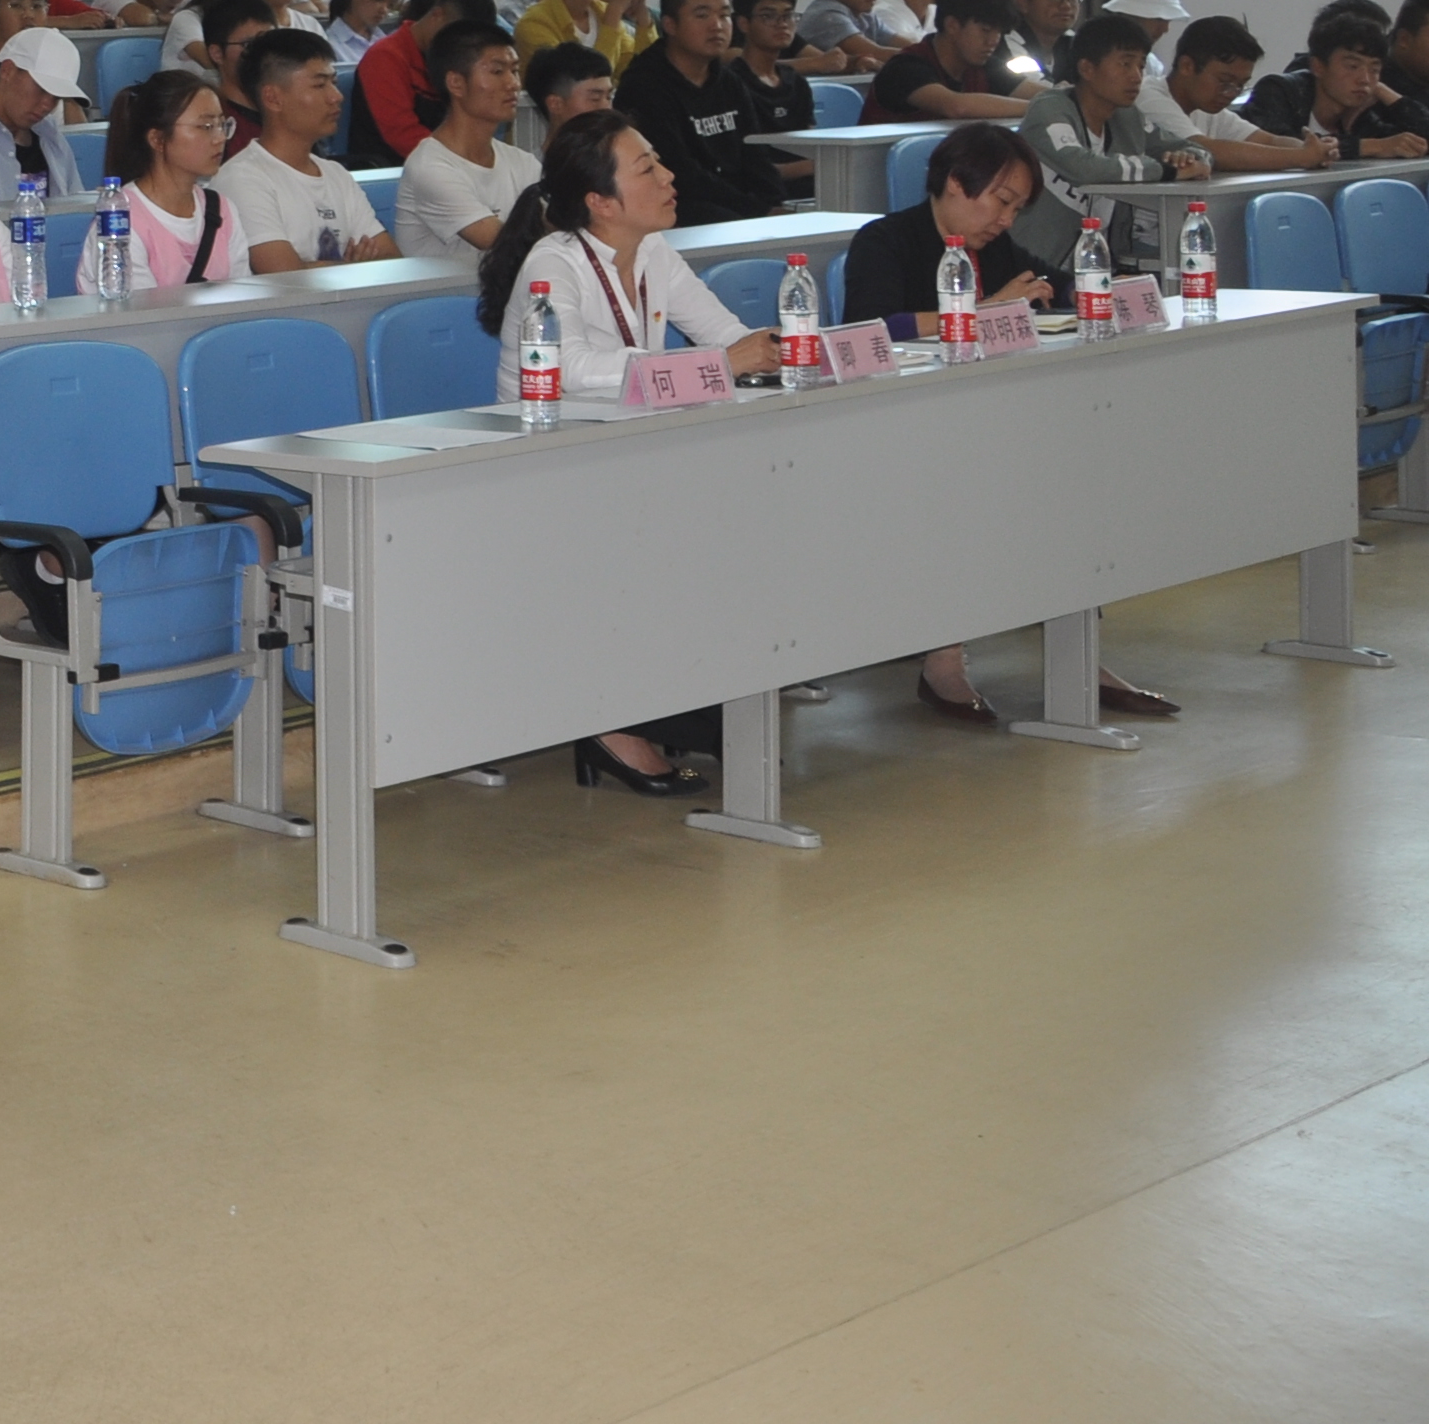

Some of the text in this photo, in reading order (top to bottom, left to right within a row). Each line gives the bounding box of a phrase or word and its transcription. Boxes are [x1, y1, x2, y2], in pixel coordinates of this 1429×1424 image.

[977, 313, 1034, 346] 邓明森
[651, 362, 727, 400] 何瑞
